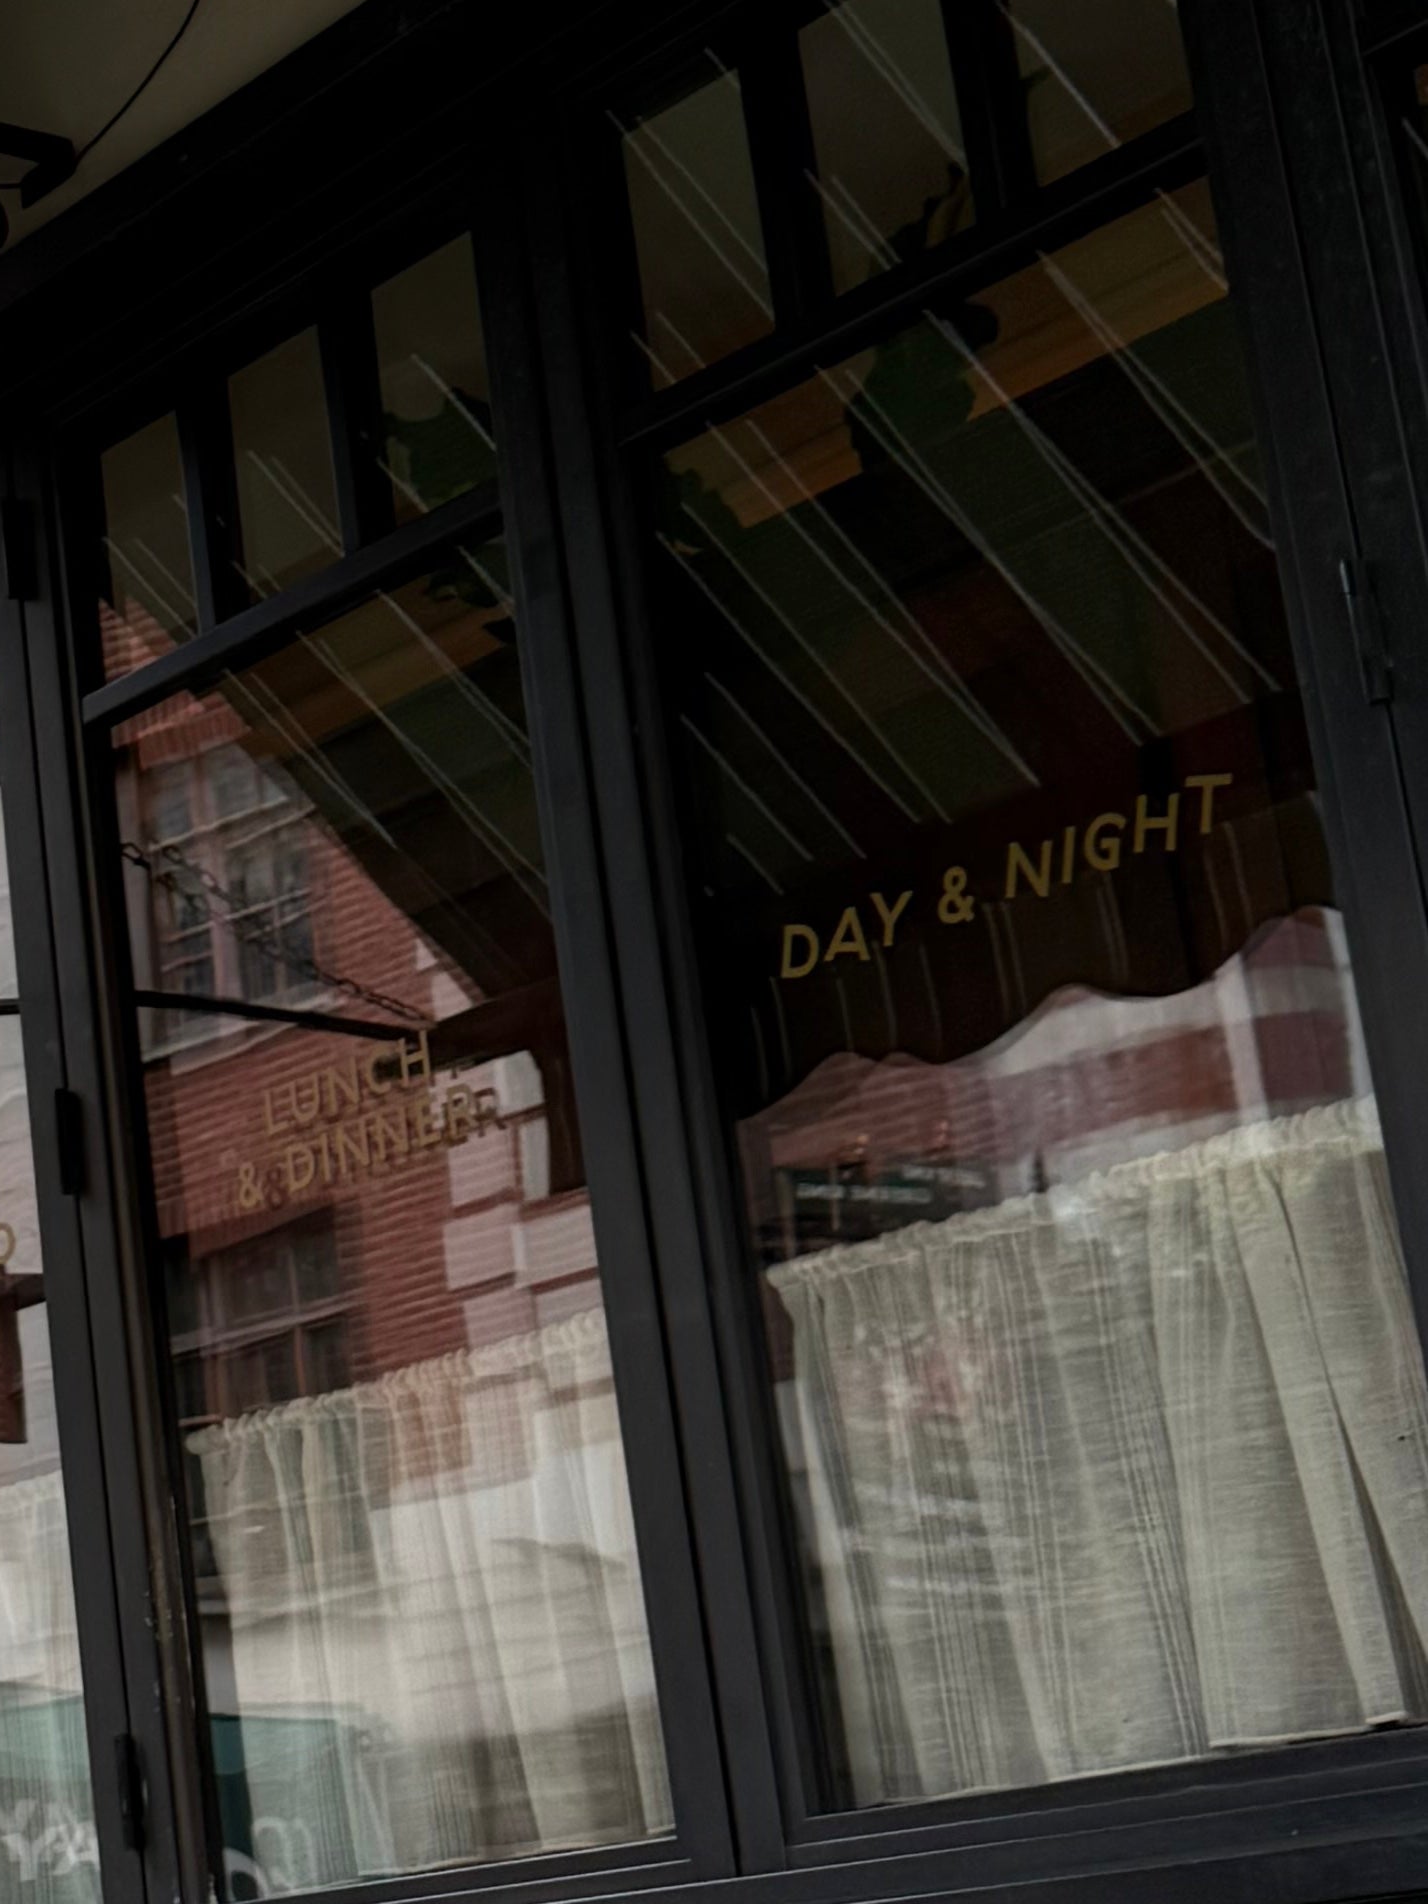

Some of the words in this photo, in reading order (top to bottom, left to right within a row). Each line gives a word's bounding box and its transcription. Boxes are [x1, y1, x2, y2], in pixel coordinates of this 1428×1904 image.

[779, 890, 913, 980] DAY
[937, 865, 976, 925] &
[1003, 773, 1233, 899] NIGHT
[262, 1029, 431, 1137] LUNCH
[237, 1161, 265, 1211] &
[285, 1084, 477, 1193] DINNER
